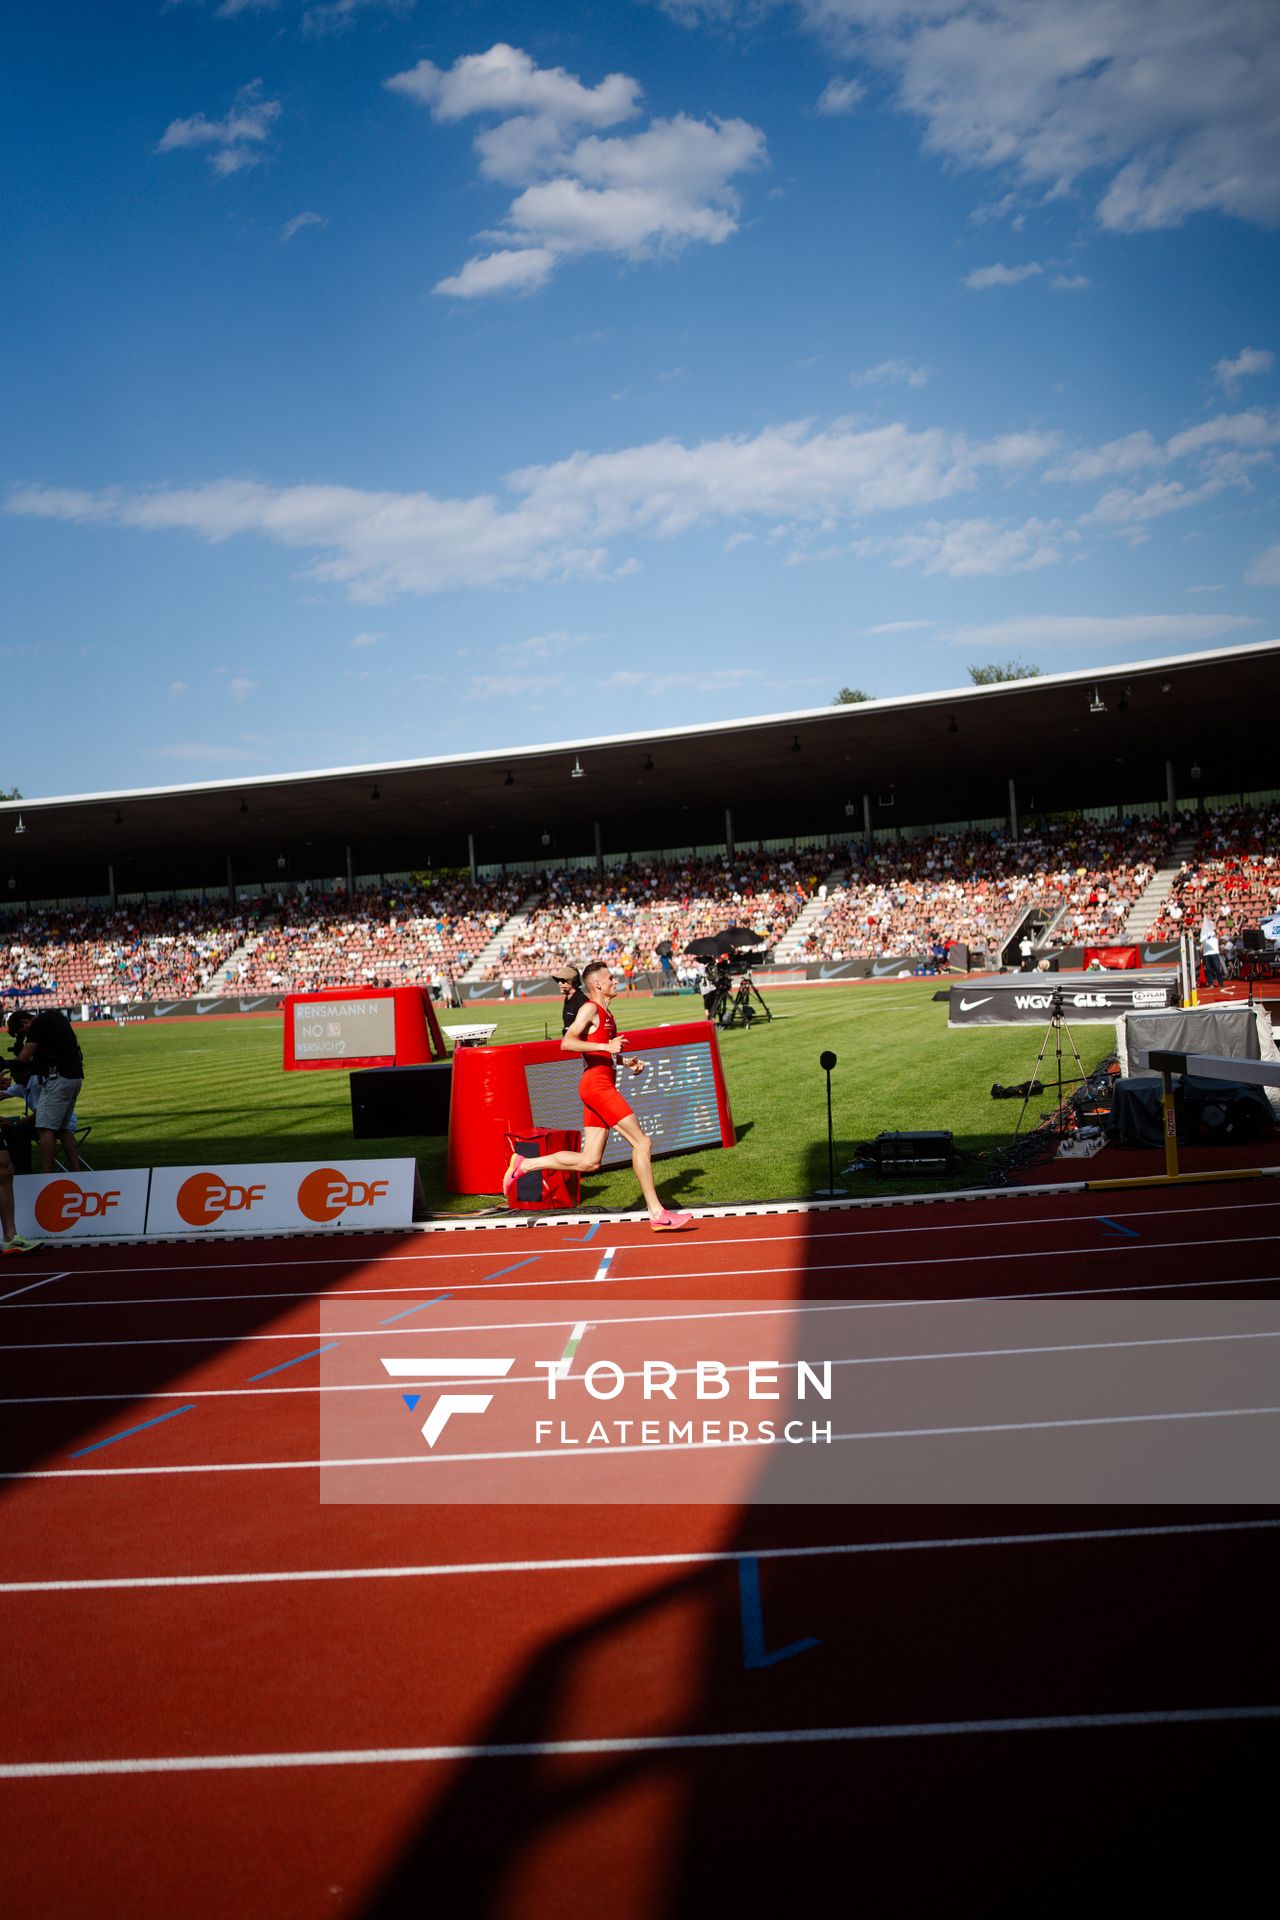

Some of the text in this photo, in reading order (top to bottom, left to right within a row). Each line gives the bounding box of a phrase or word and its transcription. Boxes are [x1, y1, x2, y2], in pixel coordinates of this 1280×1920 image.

[296, 1002, 379, 1019] RENSMANN N
[1015, 995, 1053, 1009] WGV
[303, 1023, 323, 1037] NO
[60, 1190, 121, 1218] ZDF
[203, 1184, 267, 1212] ZDF
[325, 1180, 390, 1208] ZDF
